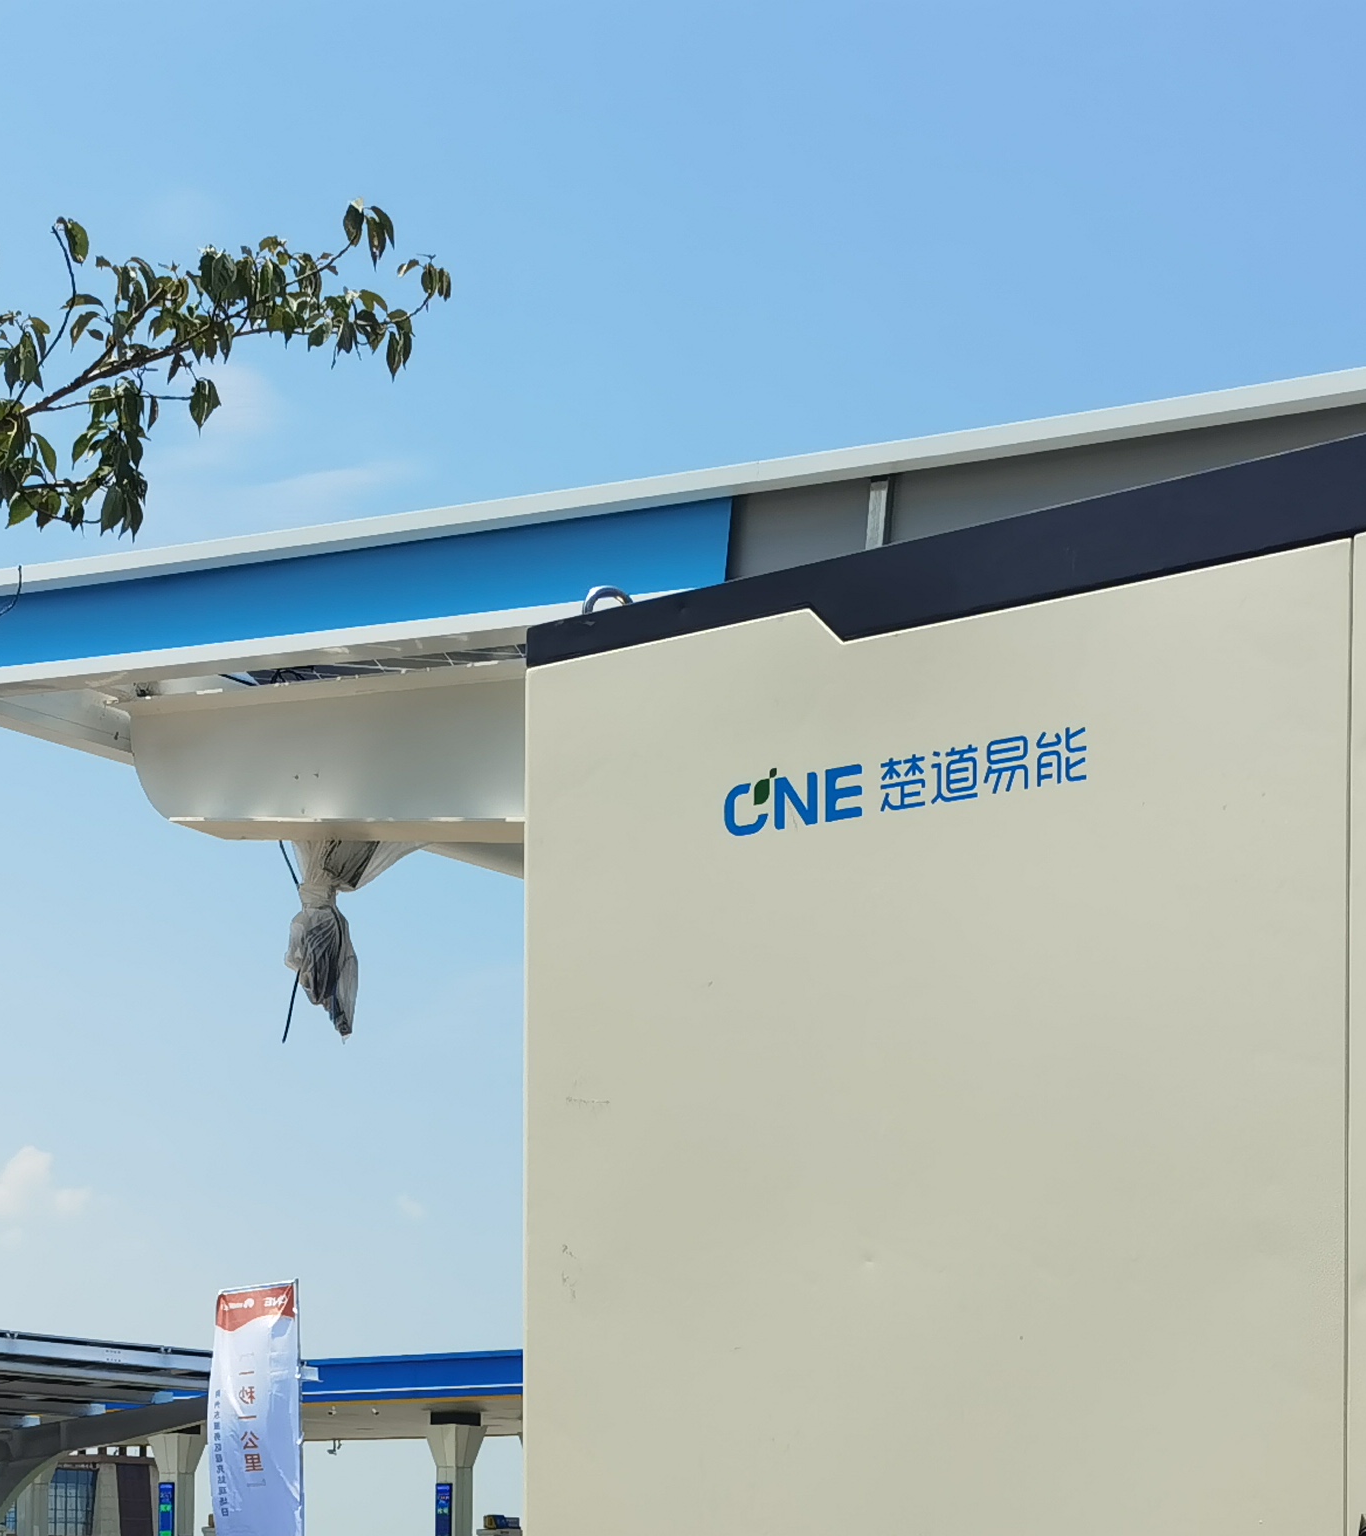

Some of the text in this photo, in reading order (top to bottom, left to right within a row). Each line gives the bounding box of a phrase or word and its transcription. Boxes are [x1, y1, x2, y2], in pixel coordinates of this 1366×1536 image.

[723, 727, 1087, 837] CNE 楚道易能
